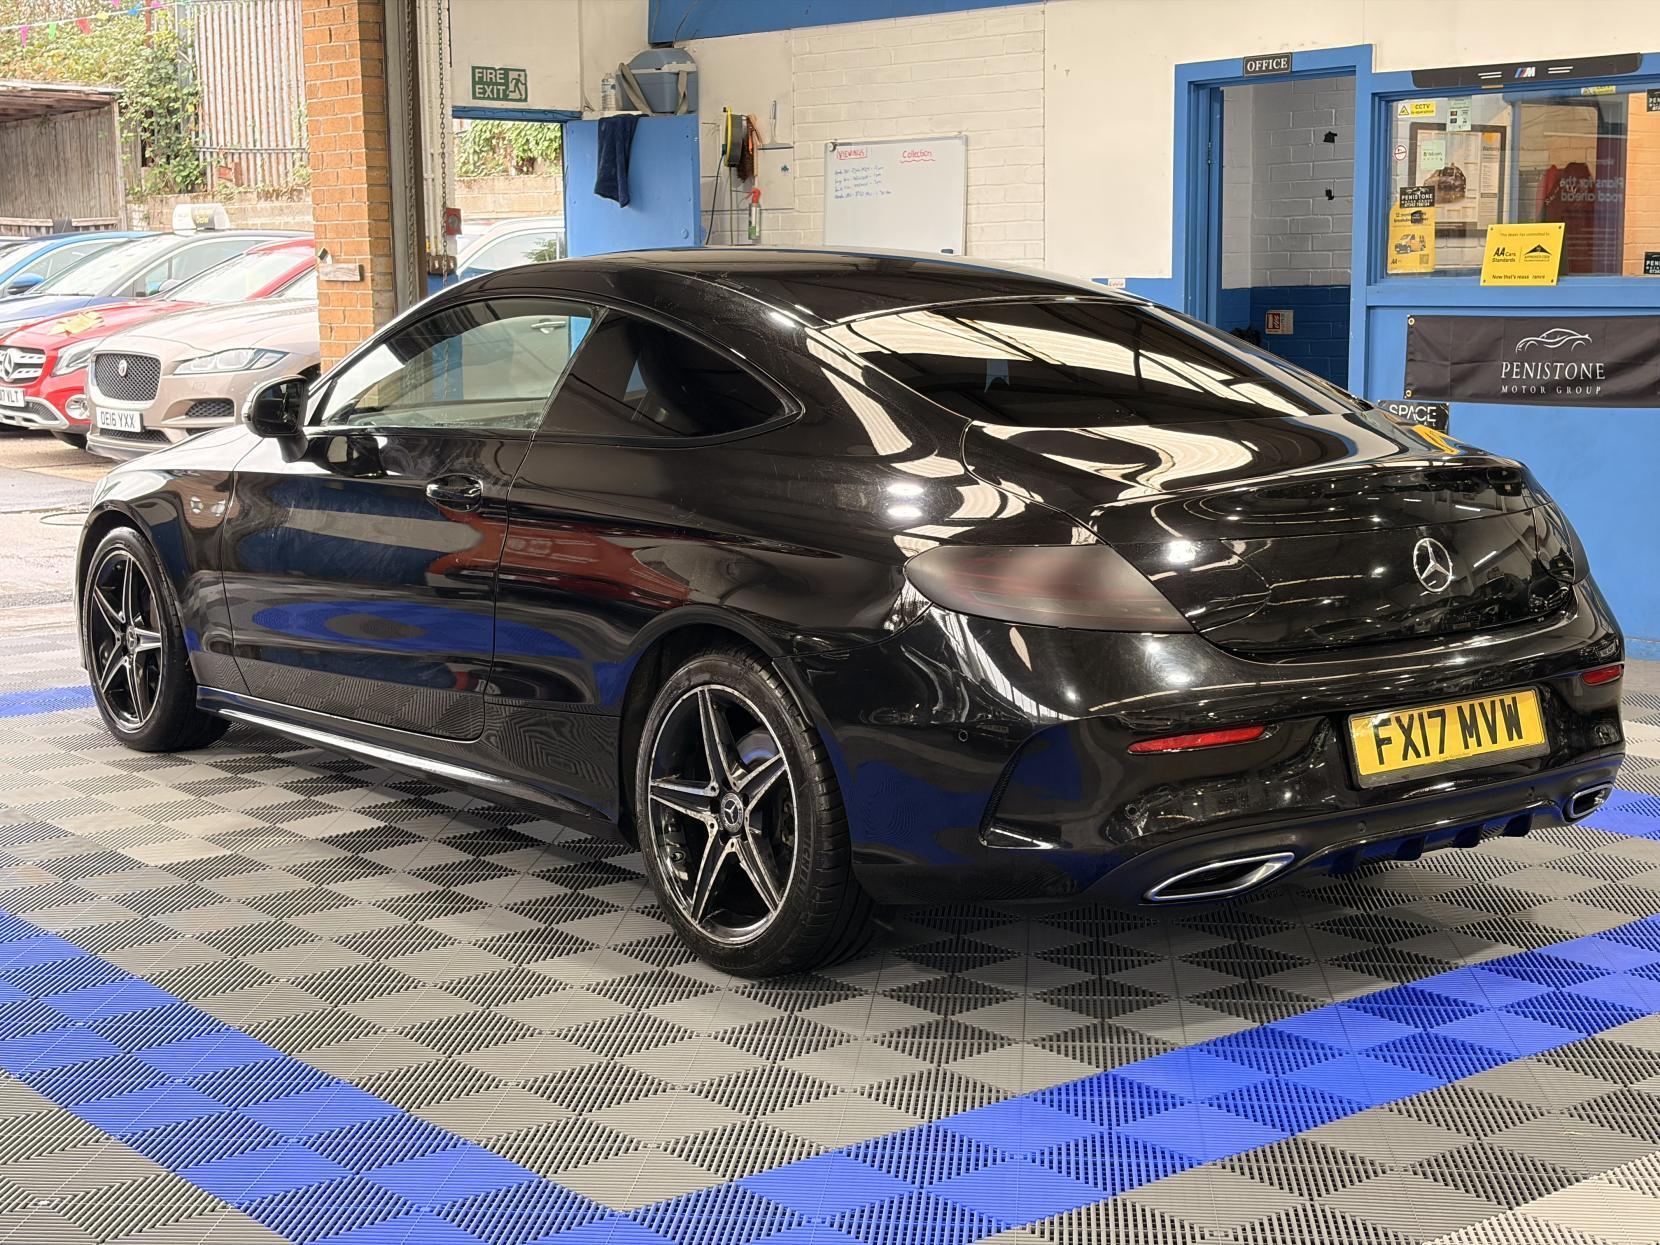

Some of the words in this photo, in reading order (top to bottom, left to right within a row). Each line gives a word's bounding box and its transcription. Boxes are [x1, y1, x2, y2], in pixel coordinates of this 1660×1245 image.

[1247, 58, 1288, 71] OFFICE
[475, 69, 505, 83] FIRE
[475, 84, 506, 99] EXIT
[839, 149, 865, 158] VIEWINGS
[902, 149, 933, 158] Collection
[1493, 246, 1506, 257] AA
[1501, 361, 1606, 380] PENISTONE
[1501, 385, 1546, 394] MOTOR
[1556, 386, 1602, 396] GROUP
[100, 411, 116, 426] OE16
[118, 412, 136, 428] YXX
[1389, 404, 1437, 422] SPACE
[1372, 708, 1446, 766] FX17
[1457, 696, 1524, 750] MVW
